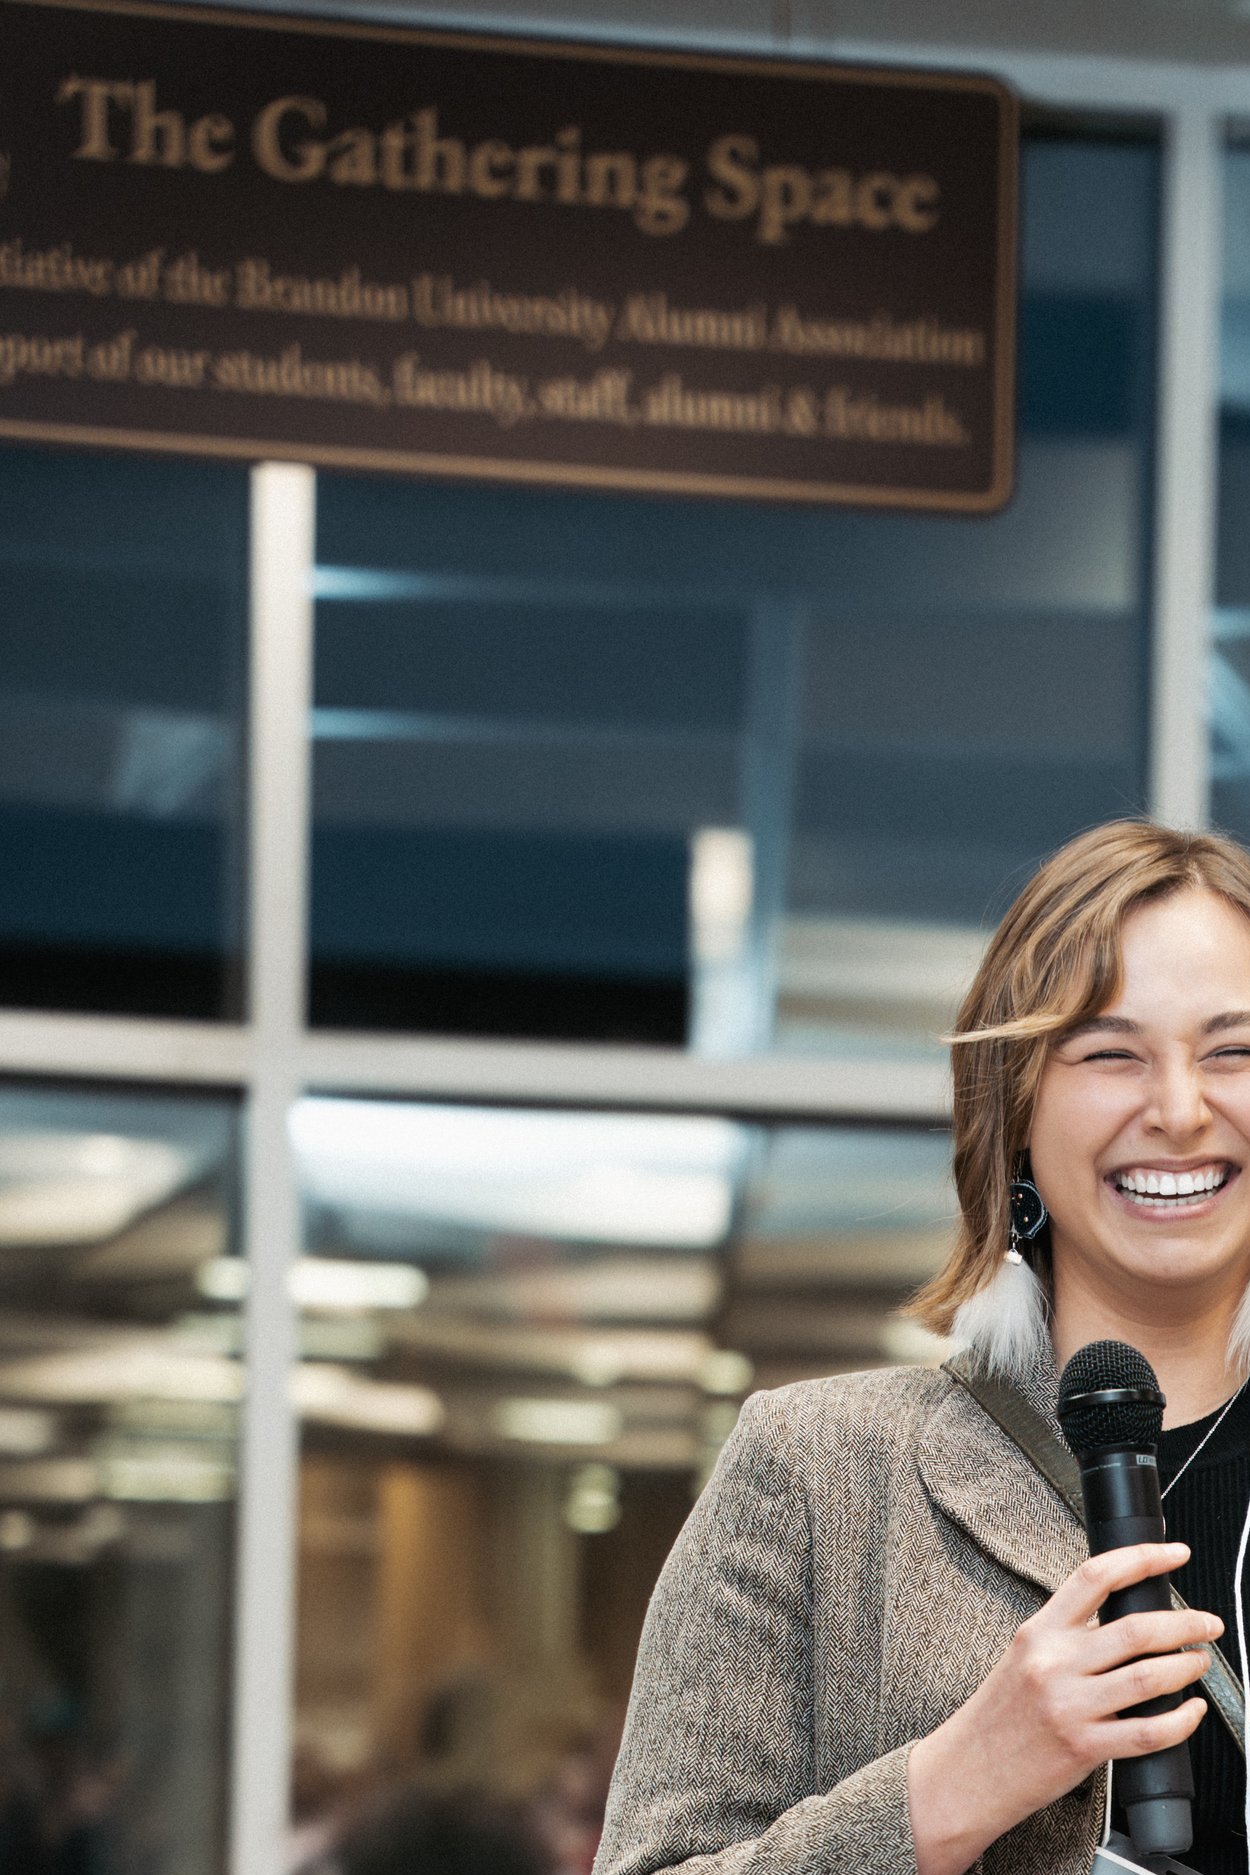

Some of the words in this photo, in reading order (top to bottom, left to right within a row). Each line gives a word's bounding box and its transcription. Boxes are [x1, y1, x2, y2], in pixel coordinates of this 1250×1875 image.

[56, 74, 236, 174] The
[252, 92, 691, 238] Gathering
[705, 134, 942, 246] Space
[87, 328, 138, 382] of
[116, 247, 164, 298] of
[164, 250, 230, 306] the
[233, 256, 408, 320] Brandon
[409, 272, 614, 350] University
[617, 290, 768, 350] Alumni
[768, 302, 986, 366] Association
